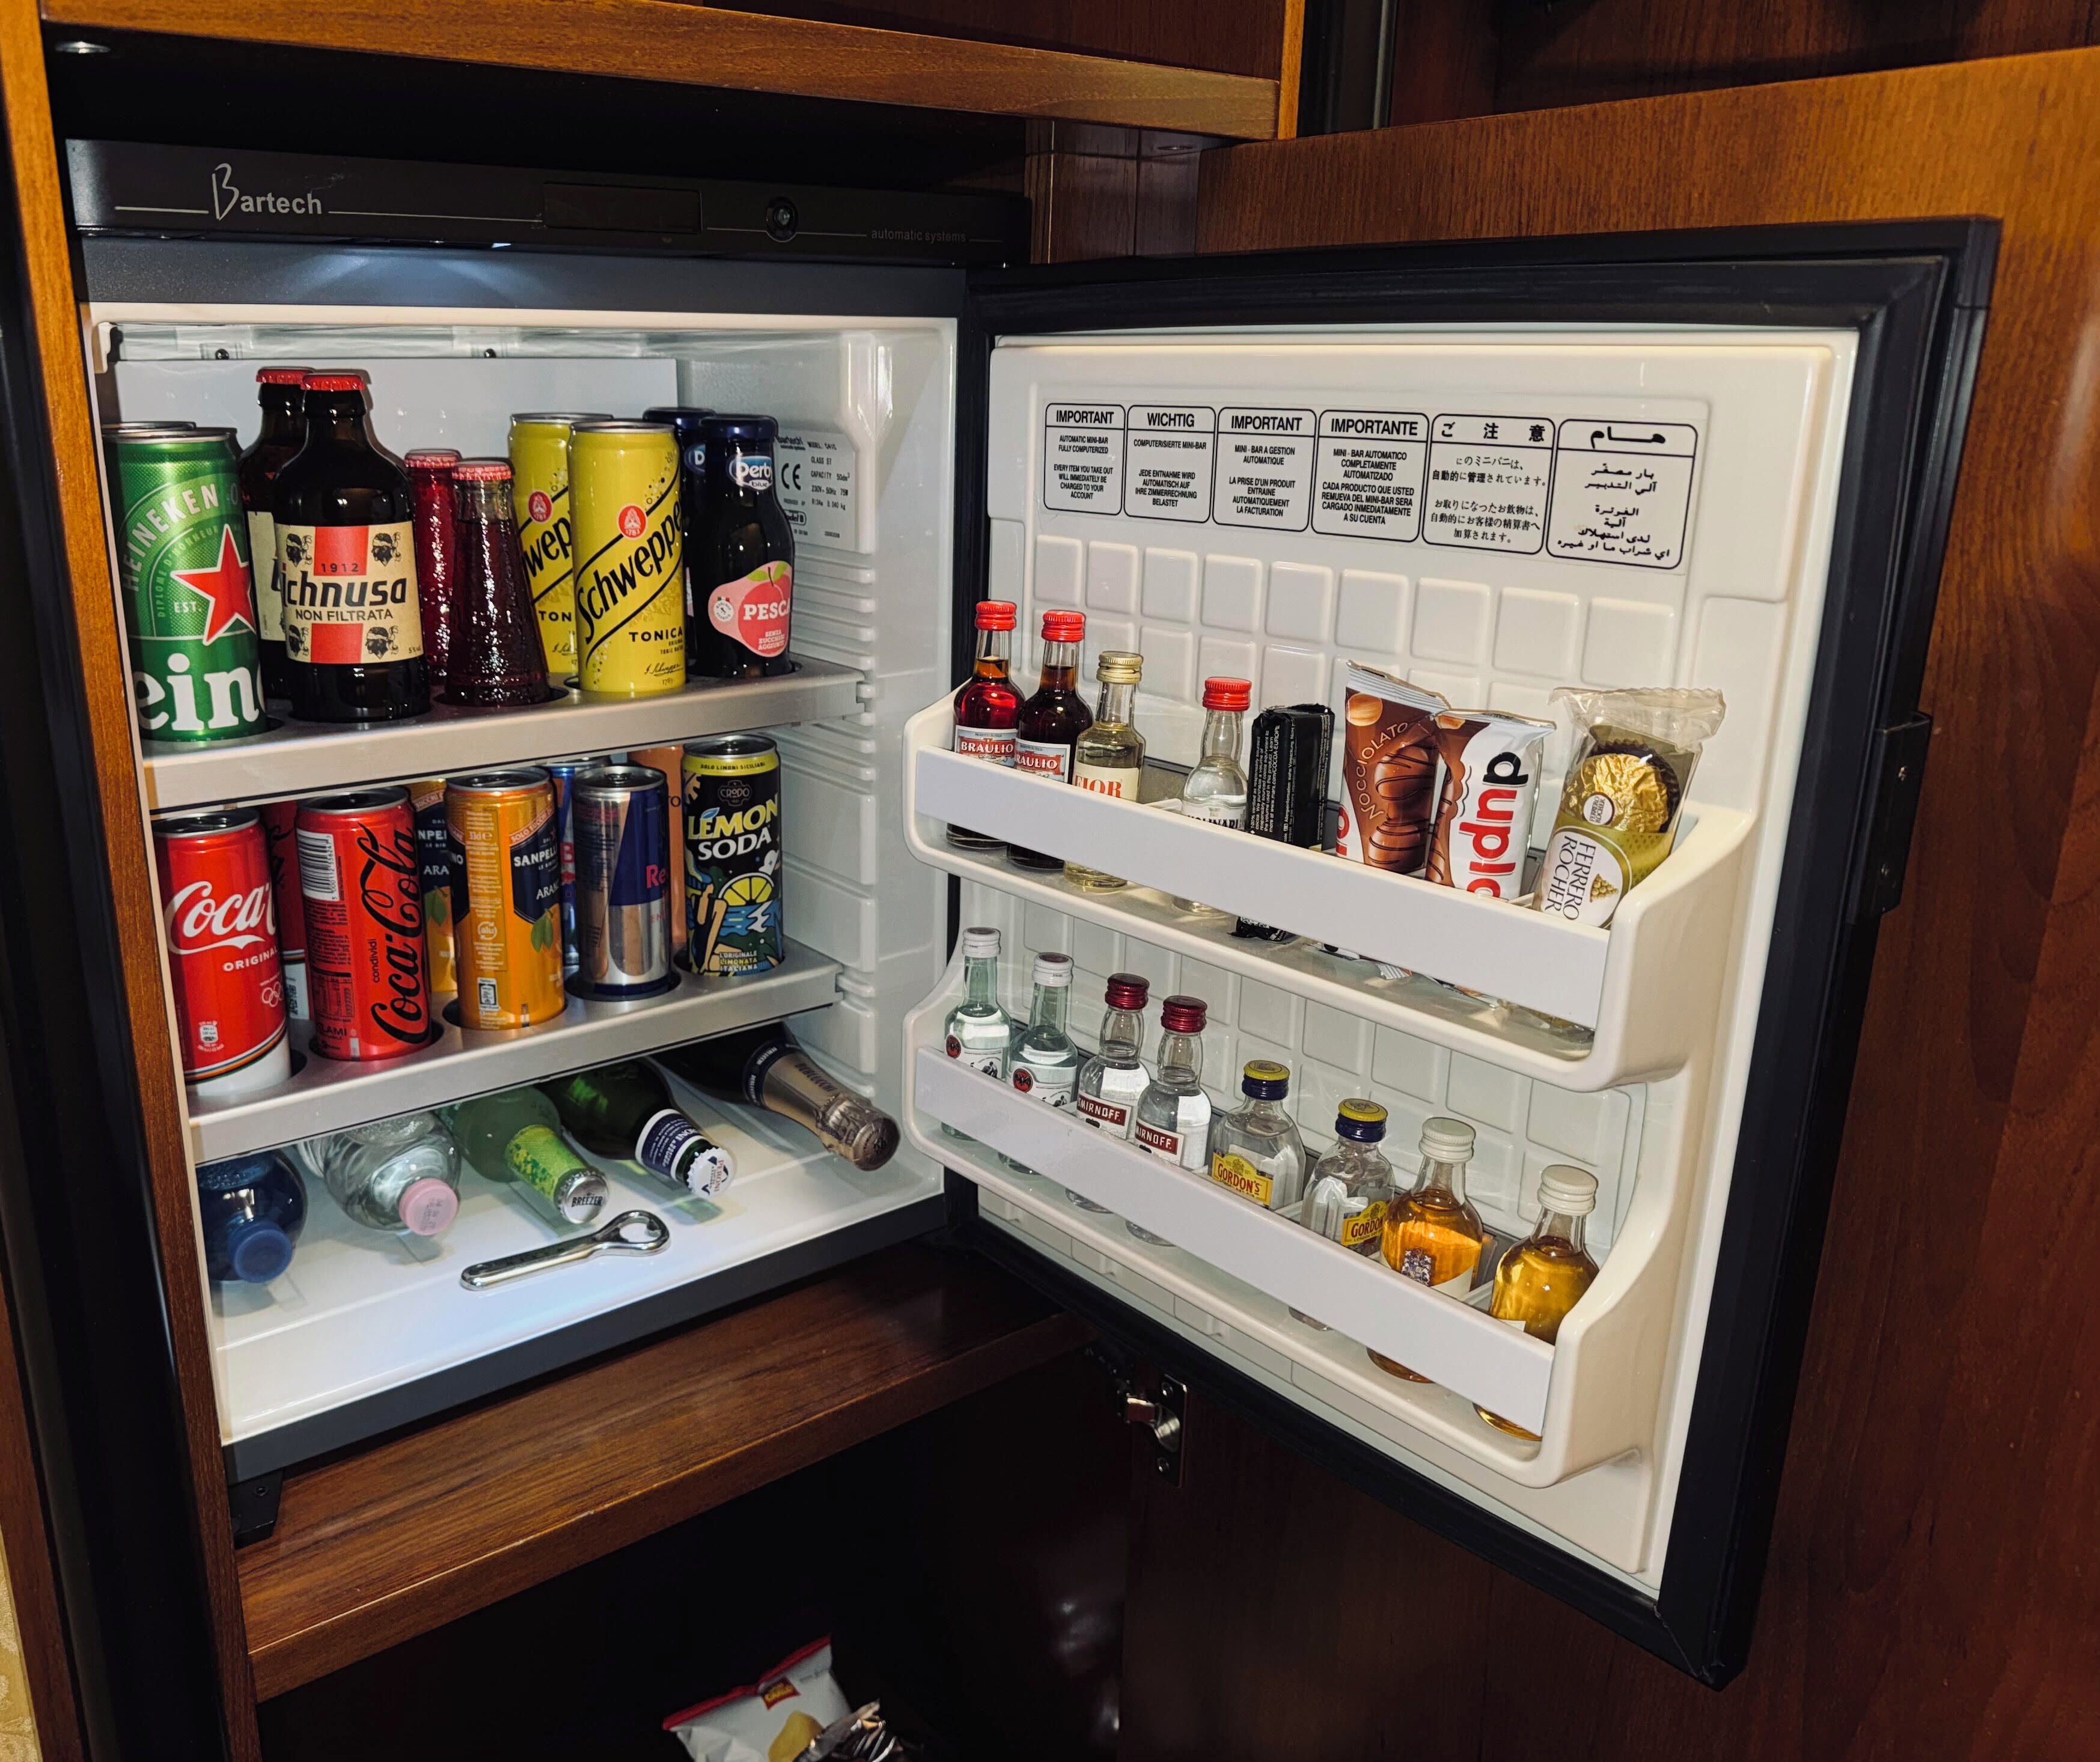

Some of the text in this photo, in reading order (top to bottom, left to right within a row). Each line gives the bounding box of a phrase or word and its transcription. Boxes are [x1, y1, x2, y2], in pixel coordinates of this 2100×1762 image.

[212, 163, 323, 221] Bartech
[871, 228, 966, 243] automatic systems
[1056, 410, 1114, 424] IMPORTANT
[1147, 412, 1195, 427] WICHTIG
[1232, 415, 1302, 431] IMPORTANT
[1331, 418, 1418, 436] IMPORTANTE
[1072, 445, 1108, 454] COMPUTERIZED
[1182, 441, 1206, 450] MINI-BAR
[1251, 445, 1263, 454] BAR
[1264, 446, 1268, 454] A
[1269, 447, 1295, 455] GESTION
[1243, 456, 1284, 465] AUTOMATIQUE
[1351, 450, 1364, 458] BAR
[1365, 450, 1407, 460] AUTOMATICO
[1341, 459, 1397, 471] COMPLETAMENTE
[1139, 469, 1152, 477] JEDE
[1152, 470, 1180, 478] ENTNAHME
[1343, 470, 1393, 481] AUTOMATIZADO
[1143, 479, 1179, 488] AUTOMATISCH
[1237, 477, 1254, 486] PRISE
[1255, 478, 1268, 486] D'UN
[1269, 479, 1295, 488] PRODUIT
[1322, 481, 1414, 496] CADA PRODUCTO QUE USTED
[1070, 491, 1093, 499] ACCOUNT
[1148, 488, 1197, 499] ZIMMERRECHNUNG
[1248, 487, 1275, 496] ENTRAINE
[1322, 492, 1413, 506] REMUEVA DEL MINI-BAR SERA
[1152, 498, 1178, 507] BELASTET
[1233, 496, 1290, 507] AUTOMATIQUEMENT
[1322, 501, 1411, 516] CARGADO INMEDIATAMENTE
[1245, 507, 1283, 517] FACTURATION
[1349, 514, 1358, 522] SU
[1360, 515, 1385, 525] CUENTA
[122, 483, 219, 592] HEINEKEN
[320, 562, 359, 573] 1912
[577, 500, 682, 645] Schweppe
[174, 600, 203, 614] EST.
[296, 608, 394, 622] NON FILTRATA
[538, 611, 572, 622] TON
[629, 626, 683, 642] TONICA
[134, 653, 266, 731] ein
[1356, 722, 1408, 820] NOCCIOLATO
[1076, 775, 1122, 799] FIOR
[688, 793, 778, 840] LEMON
[1589, 796, 1600, 823] FERRERO
[1595, 797, 1606, 824] ROCHER
[698, 827, 772, 861] SODA
[646, 865, 668, 889] Re
[1544, 835, 1578, 912] ROCHER
[1563, 841, 1596, 921] FERRERO
[367, 938, 380, 983] condividi
[1136, 1125, 1173, 1150] MIRNOFF
[713, 1159, 727, 1193] PERONI
[1218, 1163, 1261, 1194] GORDON'S
[571, 1193, 603, 1208] BREEZER
